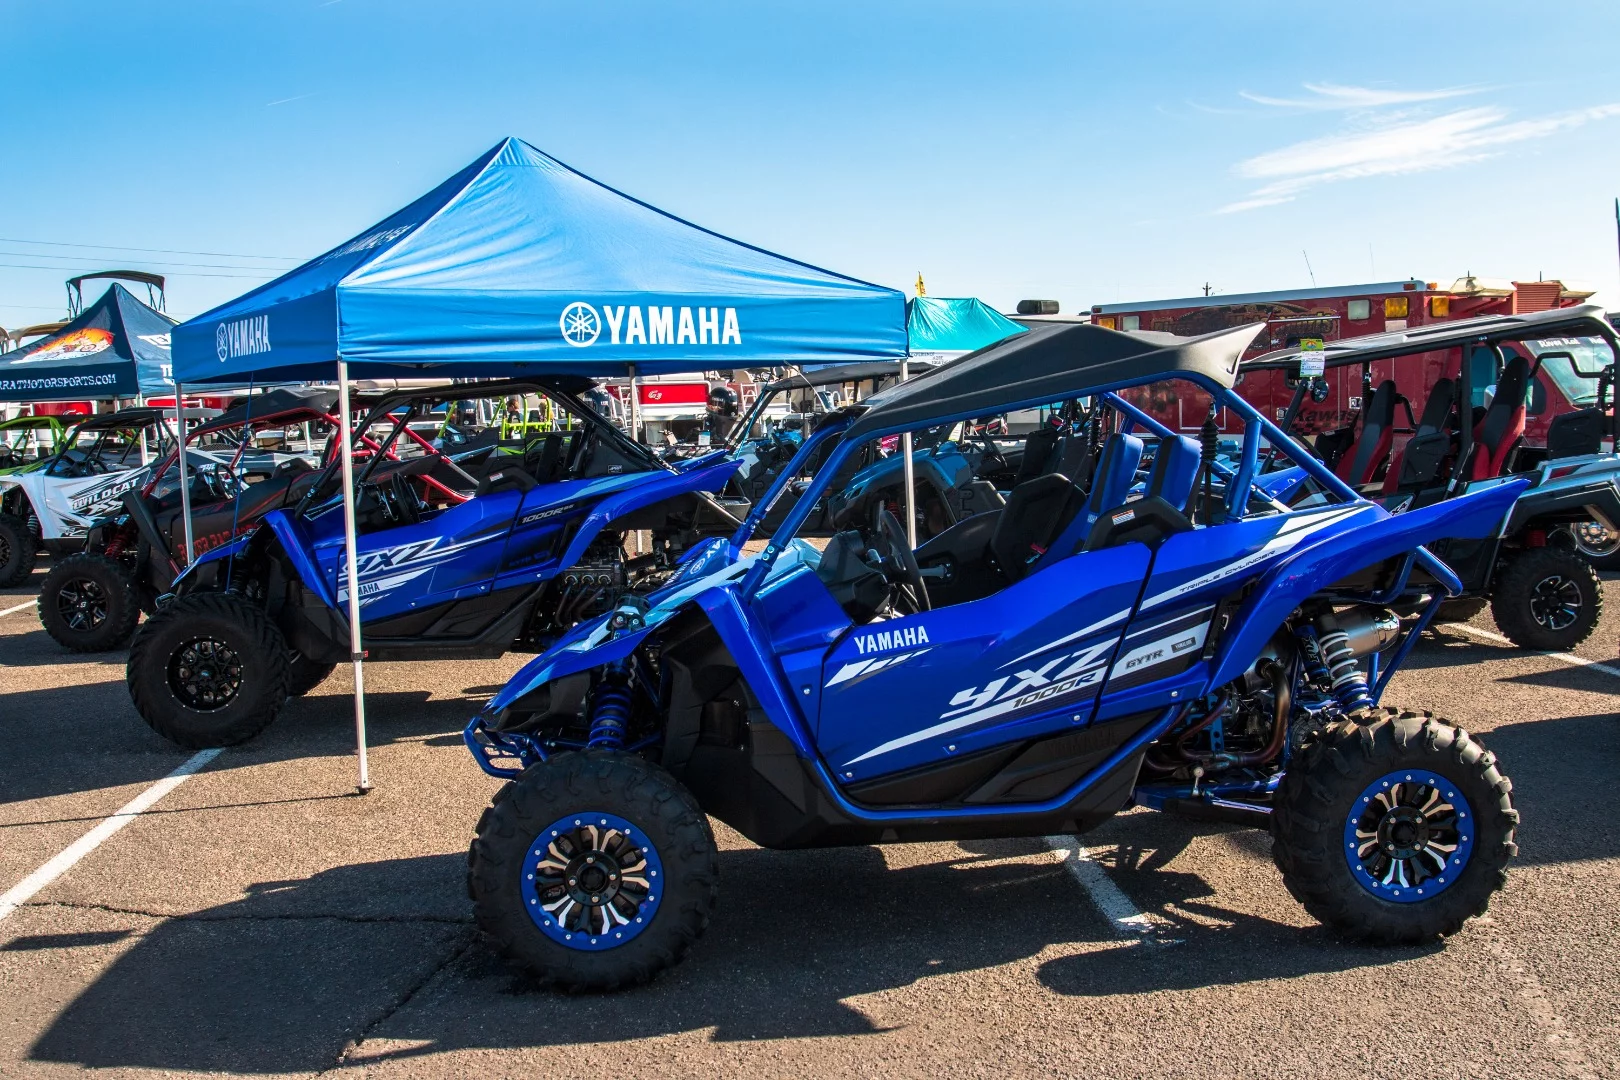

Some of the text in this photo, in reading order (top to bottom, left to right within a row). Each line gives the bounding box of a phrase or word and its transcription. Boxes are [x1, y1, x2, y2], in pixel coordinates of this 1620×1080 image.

[227, 314, 271, 359] YAMAHA
[603, 306, 742, 345] YAMAHA
[1296, 407, 1357, 423] Kawas
[73, 477, 140, 510] WILDCAT
[522, 508, 564, 524] 1000R
[1179, 550, 1276, 592] TRIPLE CYLINDER
[345, 583, 380, 599] YMAHA
[854, 625, 930, 655] YAMAHA
[1125, 649, 1165, 669] GYTR
[939, 637, 1121, 720] YXZ
[1012, 672, 1097, 709] 1000R
